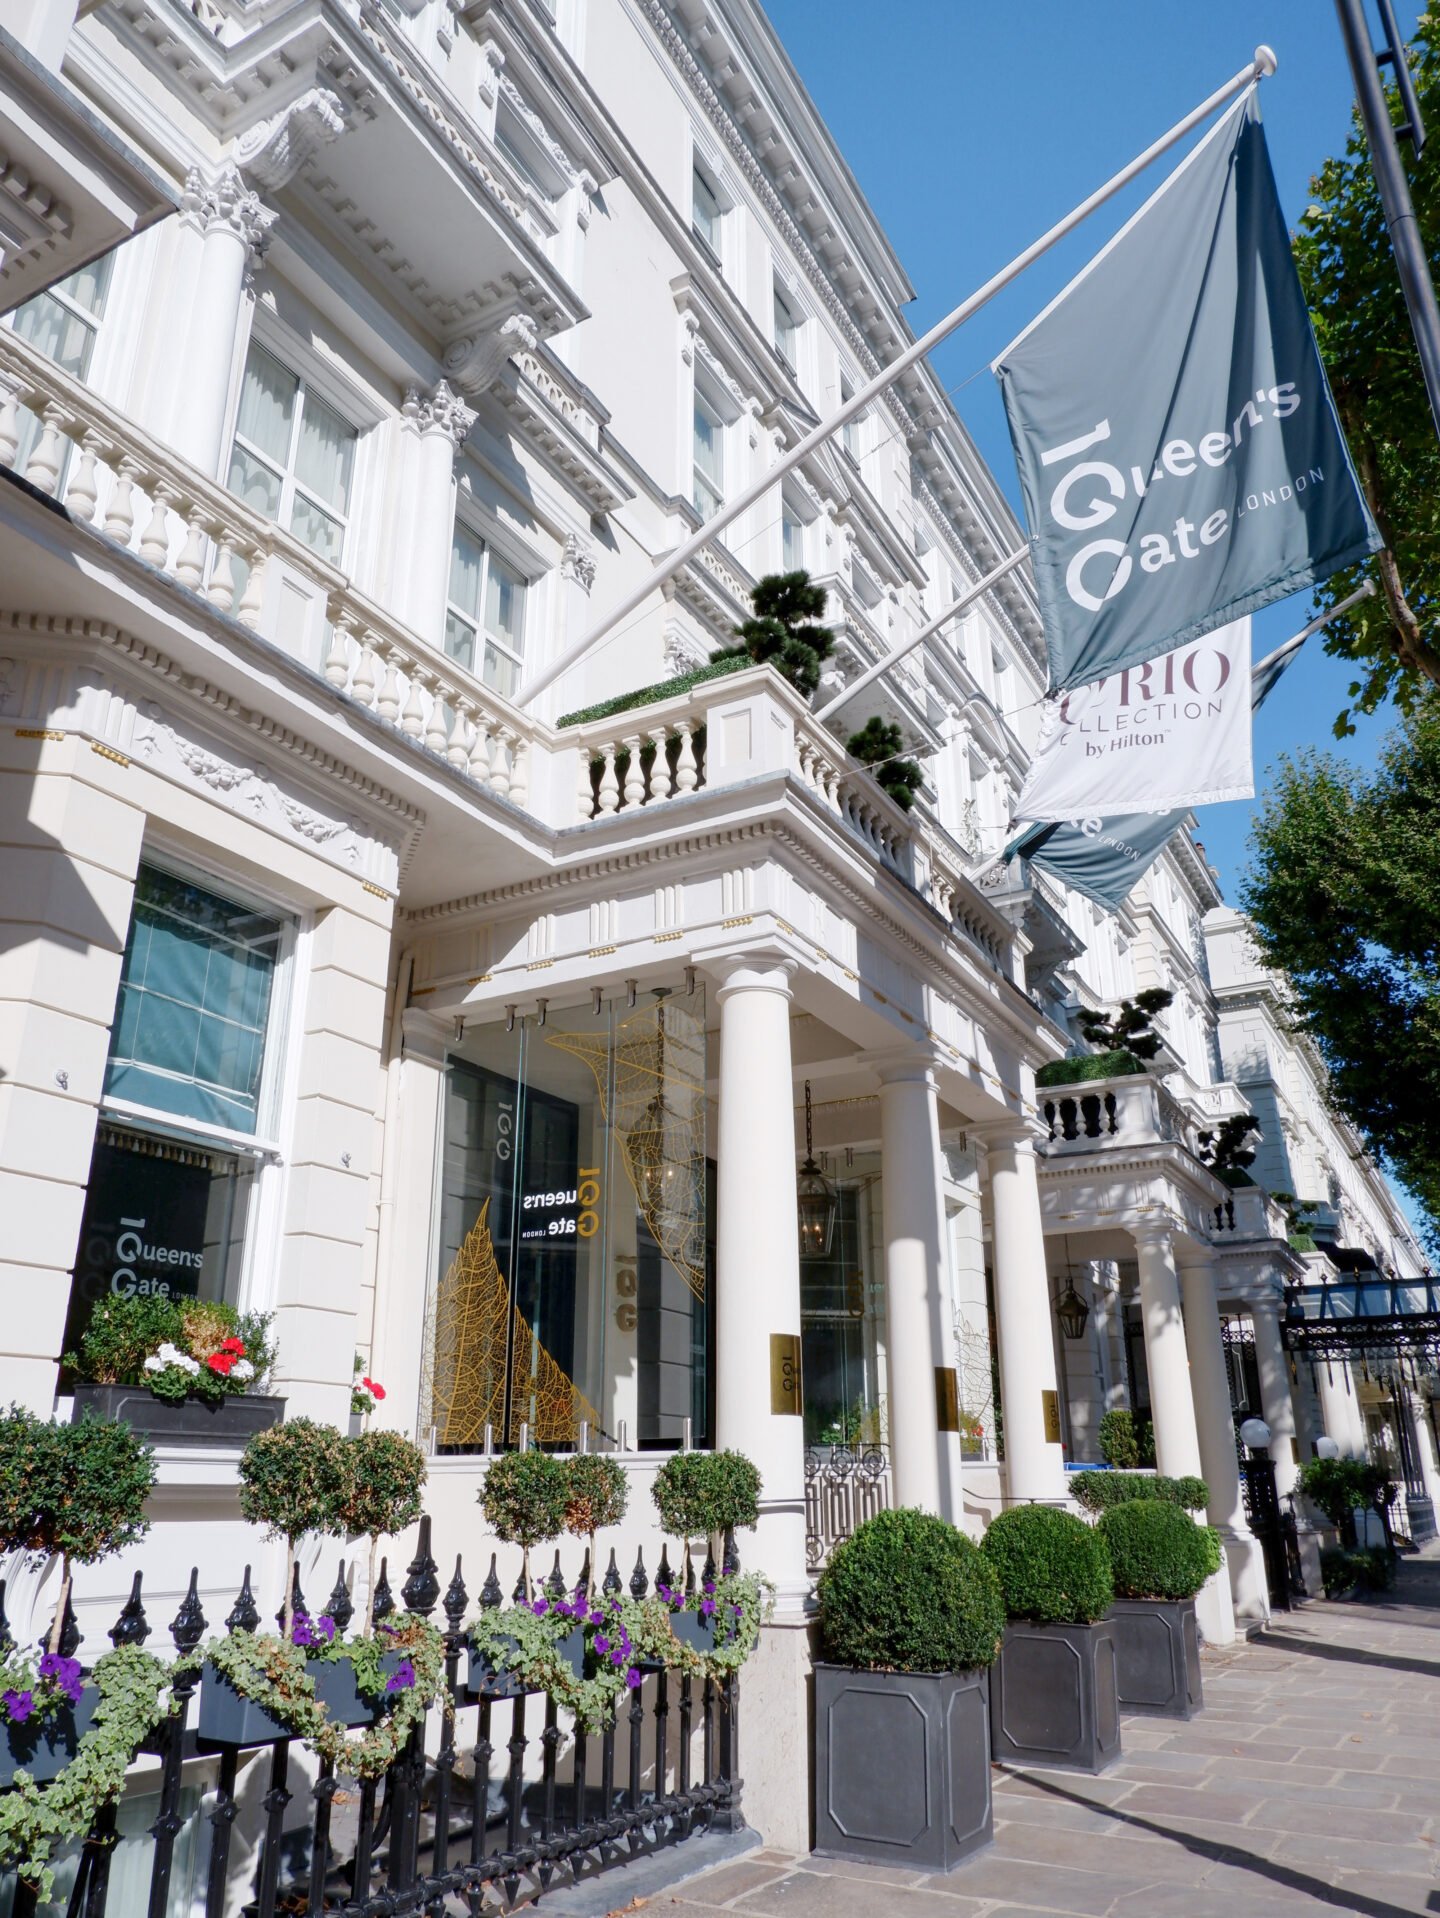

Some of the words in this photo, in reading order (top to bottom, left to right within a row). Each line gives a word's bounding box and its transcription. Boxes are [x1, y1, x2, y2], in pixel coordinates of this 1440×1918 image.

[1050, 381, 1301, 531] Queen's
[1065, 506, 1228, 612] Gate
[1237, 467, 1325, 519] LONDON
[1060, 698, 1223, 746] CLLECTION
[1086, 741, 1107, 758] by
[1098, 835, 1141, 861] LONDON
[116, 1231, 204, 1268] Queen's
[111, 1267, 170, 1301] Gate
